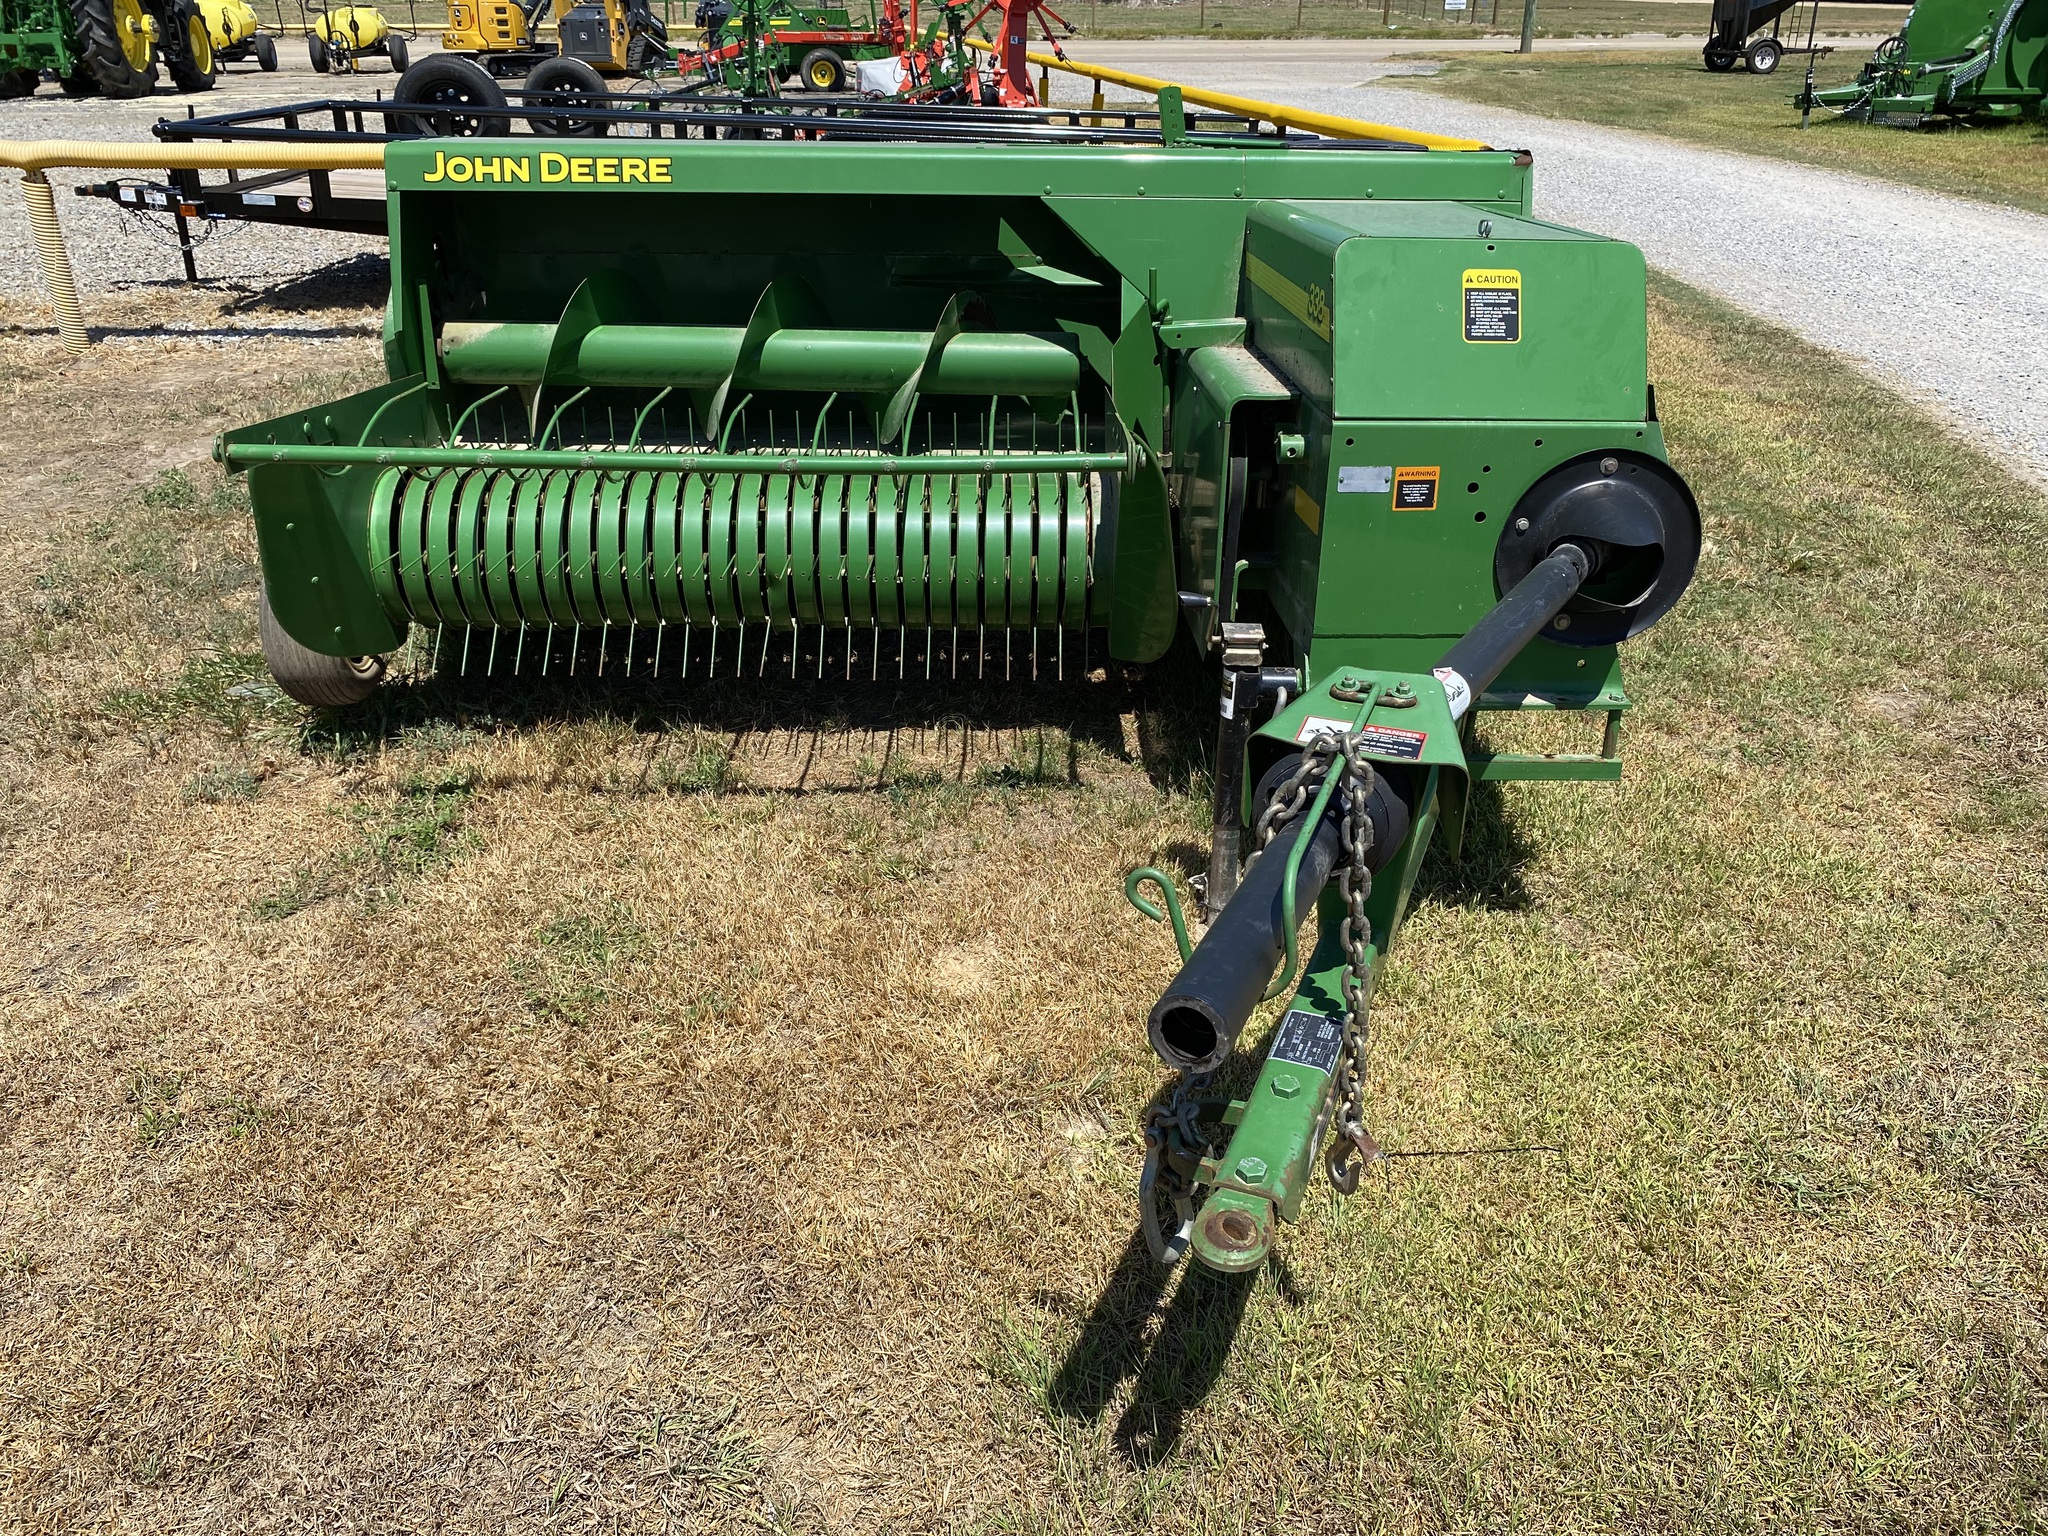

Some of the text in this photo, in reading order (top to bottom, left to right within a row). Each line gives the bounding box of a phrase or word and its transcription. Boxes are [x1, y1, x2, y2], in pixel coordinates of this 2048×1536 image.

[423, 151, 673, 184] JOHN DEERE
[1476, 274, 1518, 284] CAUTION
[1308, 282, 1325, 322] 338
[1377, 727, 1421, 738] DANGER
